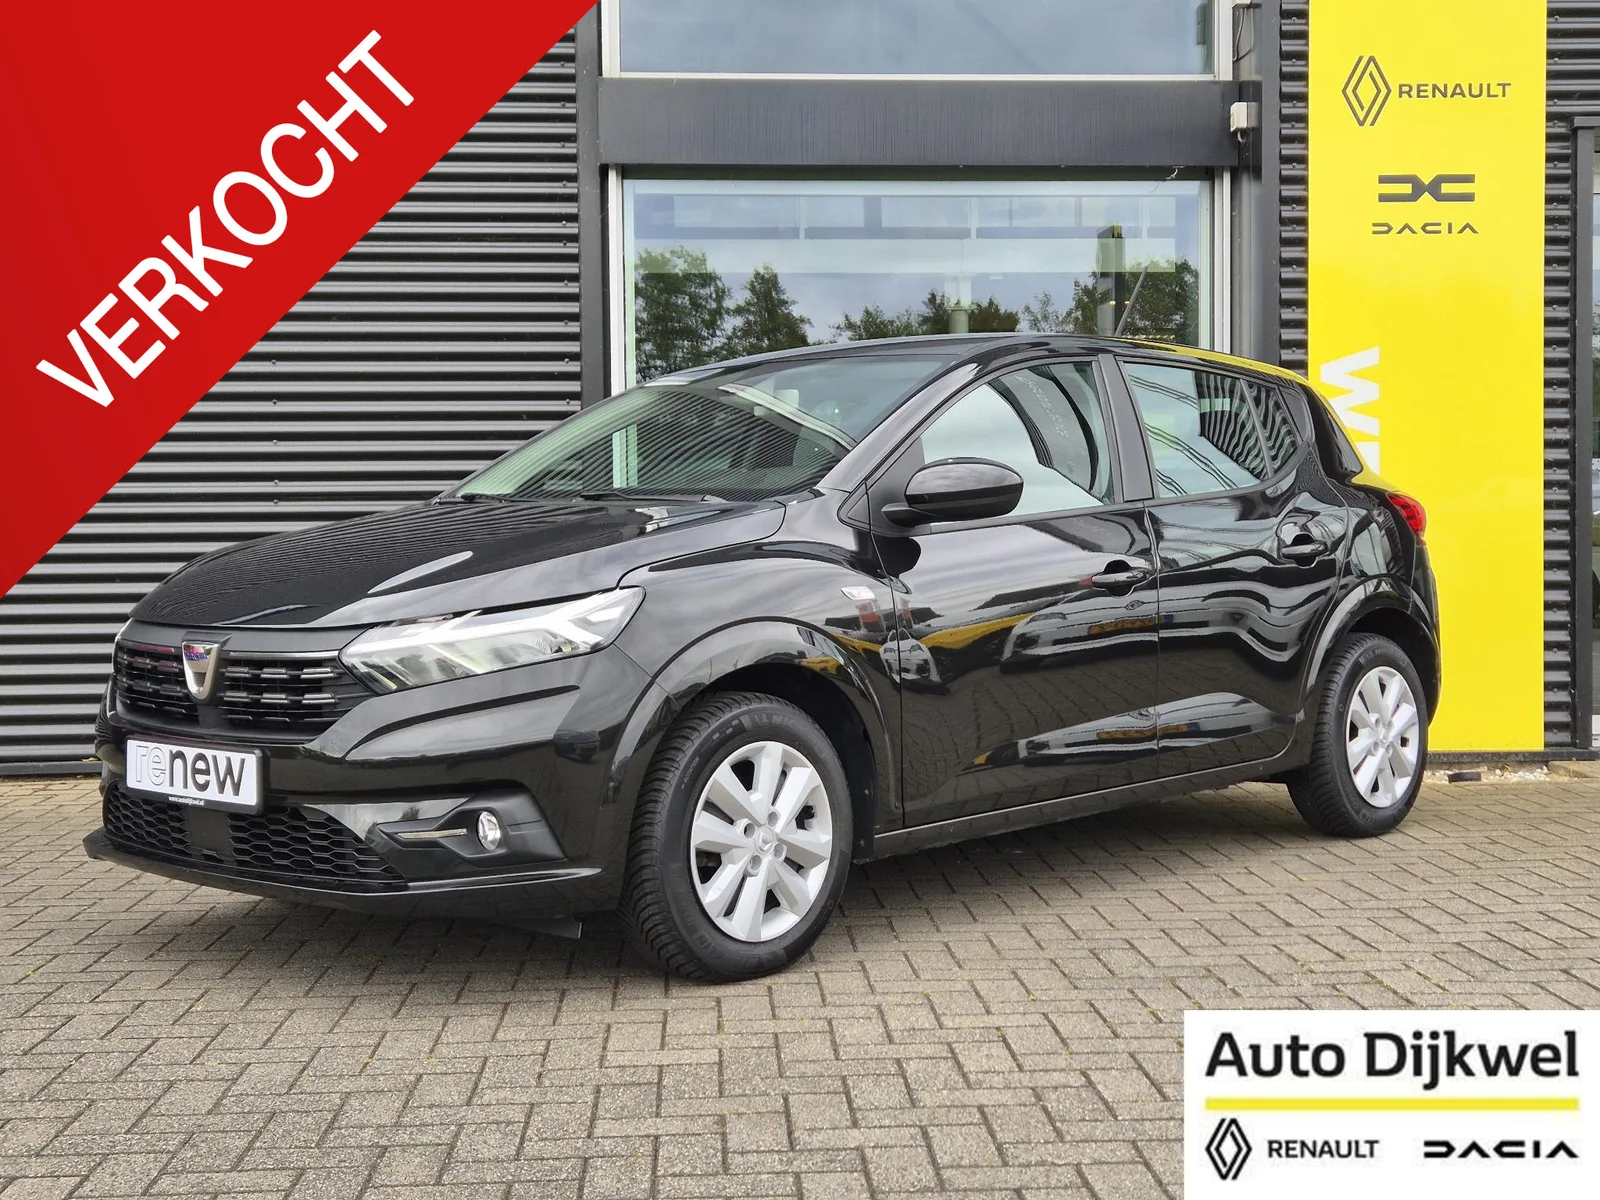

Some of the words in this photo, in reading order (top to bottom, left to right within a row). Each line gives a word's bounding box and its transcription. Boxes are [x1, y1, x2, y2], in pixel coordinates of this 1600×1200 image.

[1398, 83, 1511, 99] RENAULT
[1372, 222, 1479, 235] DACIA
[136, 745, 246, 797] renew
